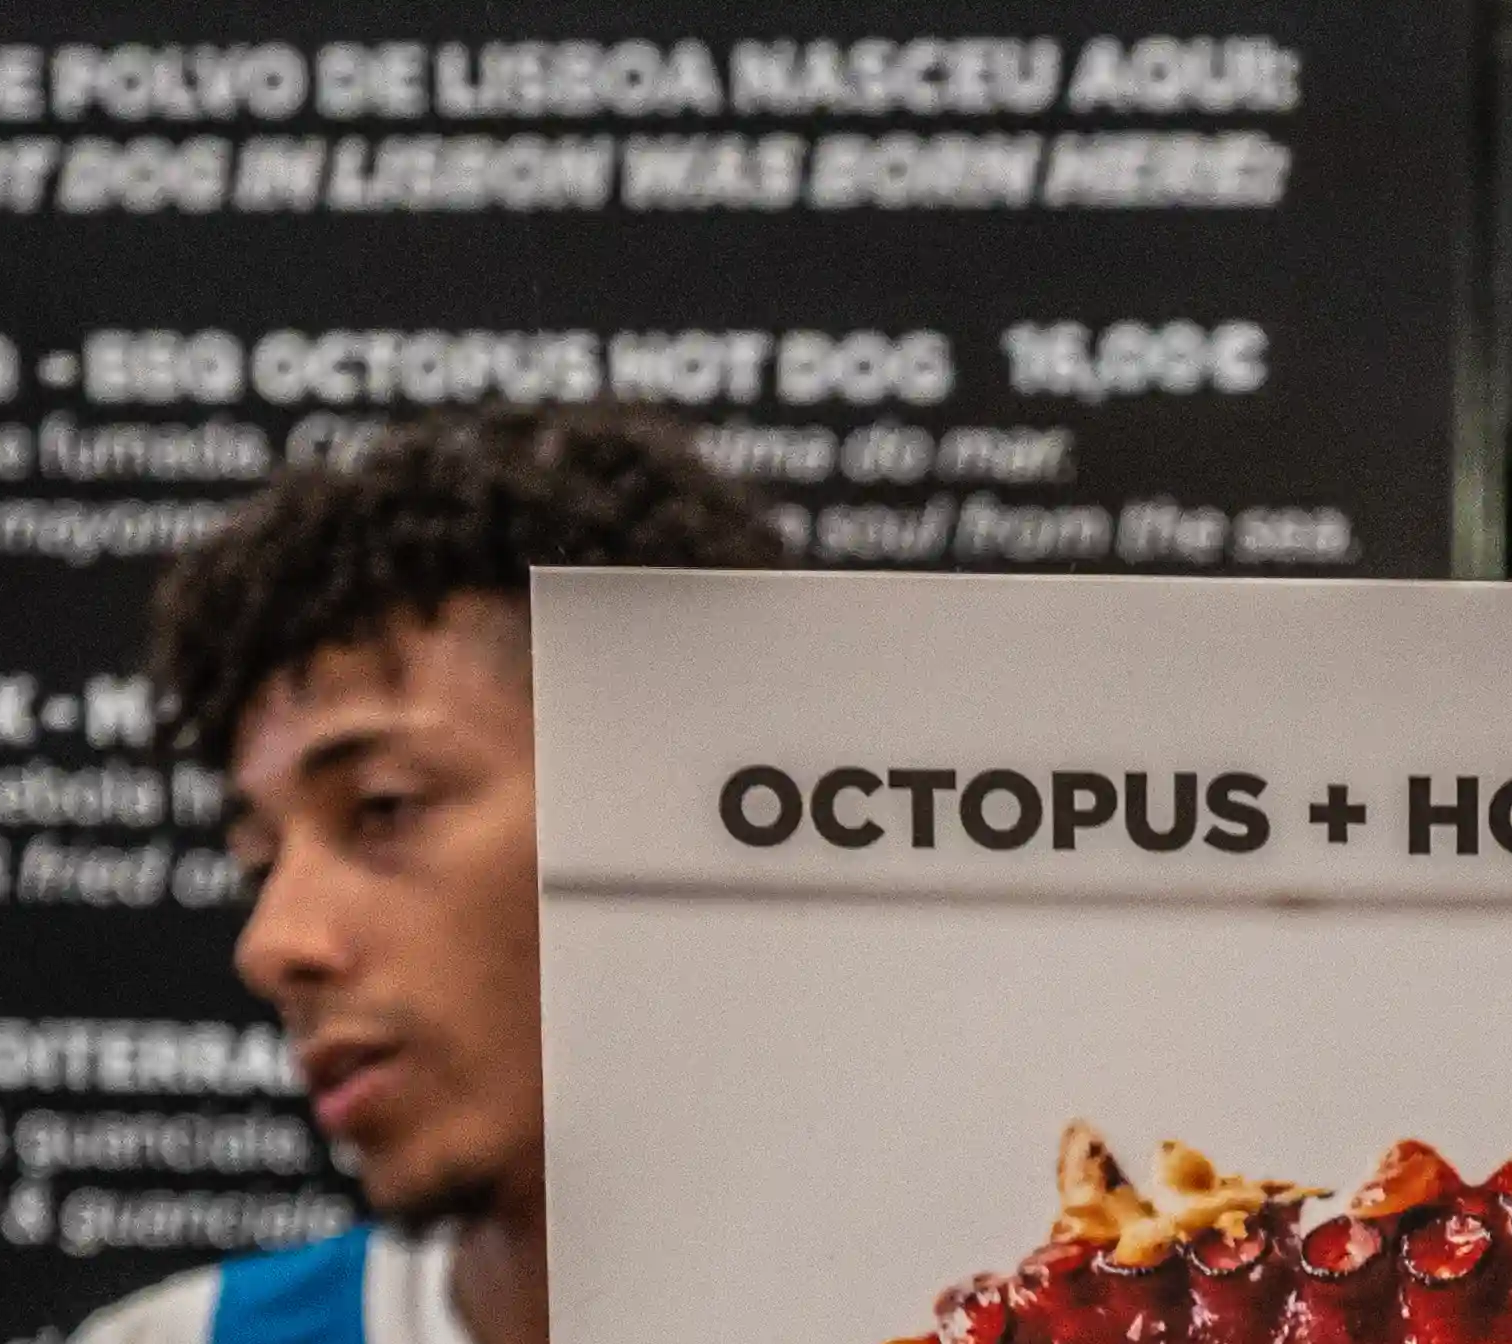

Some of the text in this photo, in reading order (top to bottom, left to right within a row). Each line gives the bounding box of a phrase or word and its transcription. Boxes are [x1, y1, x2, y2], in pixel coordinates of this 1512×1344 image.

[53, 46, 304, 117] POLVO
[317, 43, 424, 114] DE
[438, 41, 719, 114] LISBOA
[734, 39, 1060, 112] NASCEU
[59, 141, 231, 209] DOG
[233, 138, 324, 207] IN
[329, 136, 612, 207] LISBON
[622, 134, 803, 207] WAS
[805, 136, 1041, 205] BORN
[86, 332, 243, 401] BBQ
[252, 333, 600, 401] OCTOPUS
[612, 333, 772, 400] HOT
[779, 333, 953, 401] DOG
[845, 417, 931, 482] do
[817, 495, 948, 560] soul
[958, 498, 1108, 560] from
[1120, 501, 1229, 560] the
[719, 765, 1270, 852] OCTOPUS
[1310, 784, 1364, 843] +
[4, 1183, 53, 1242] &
